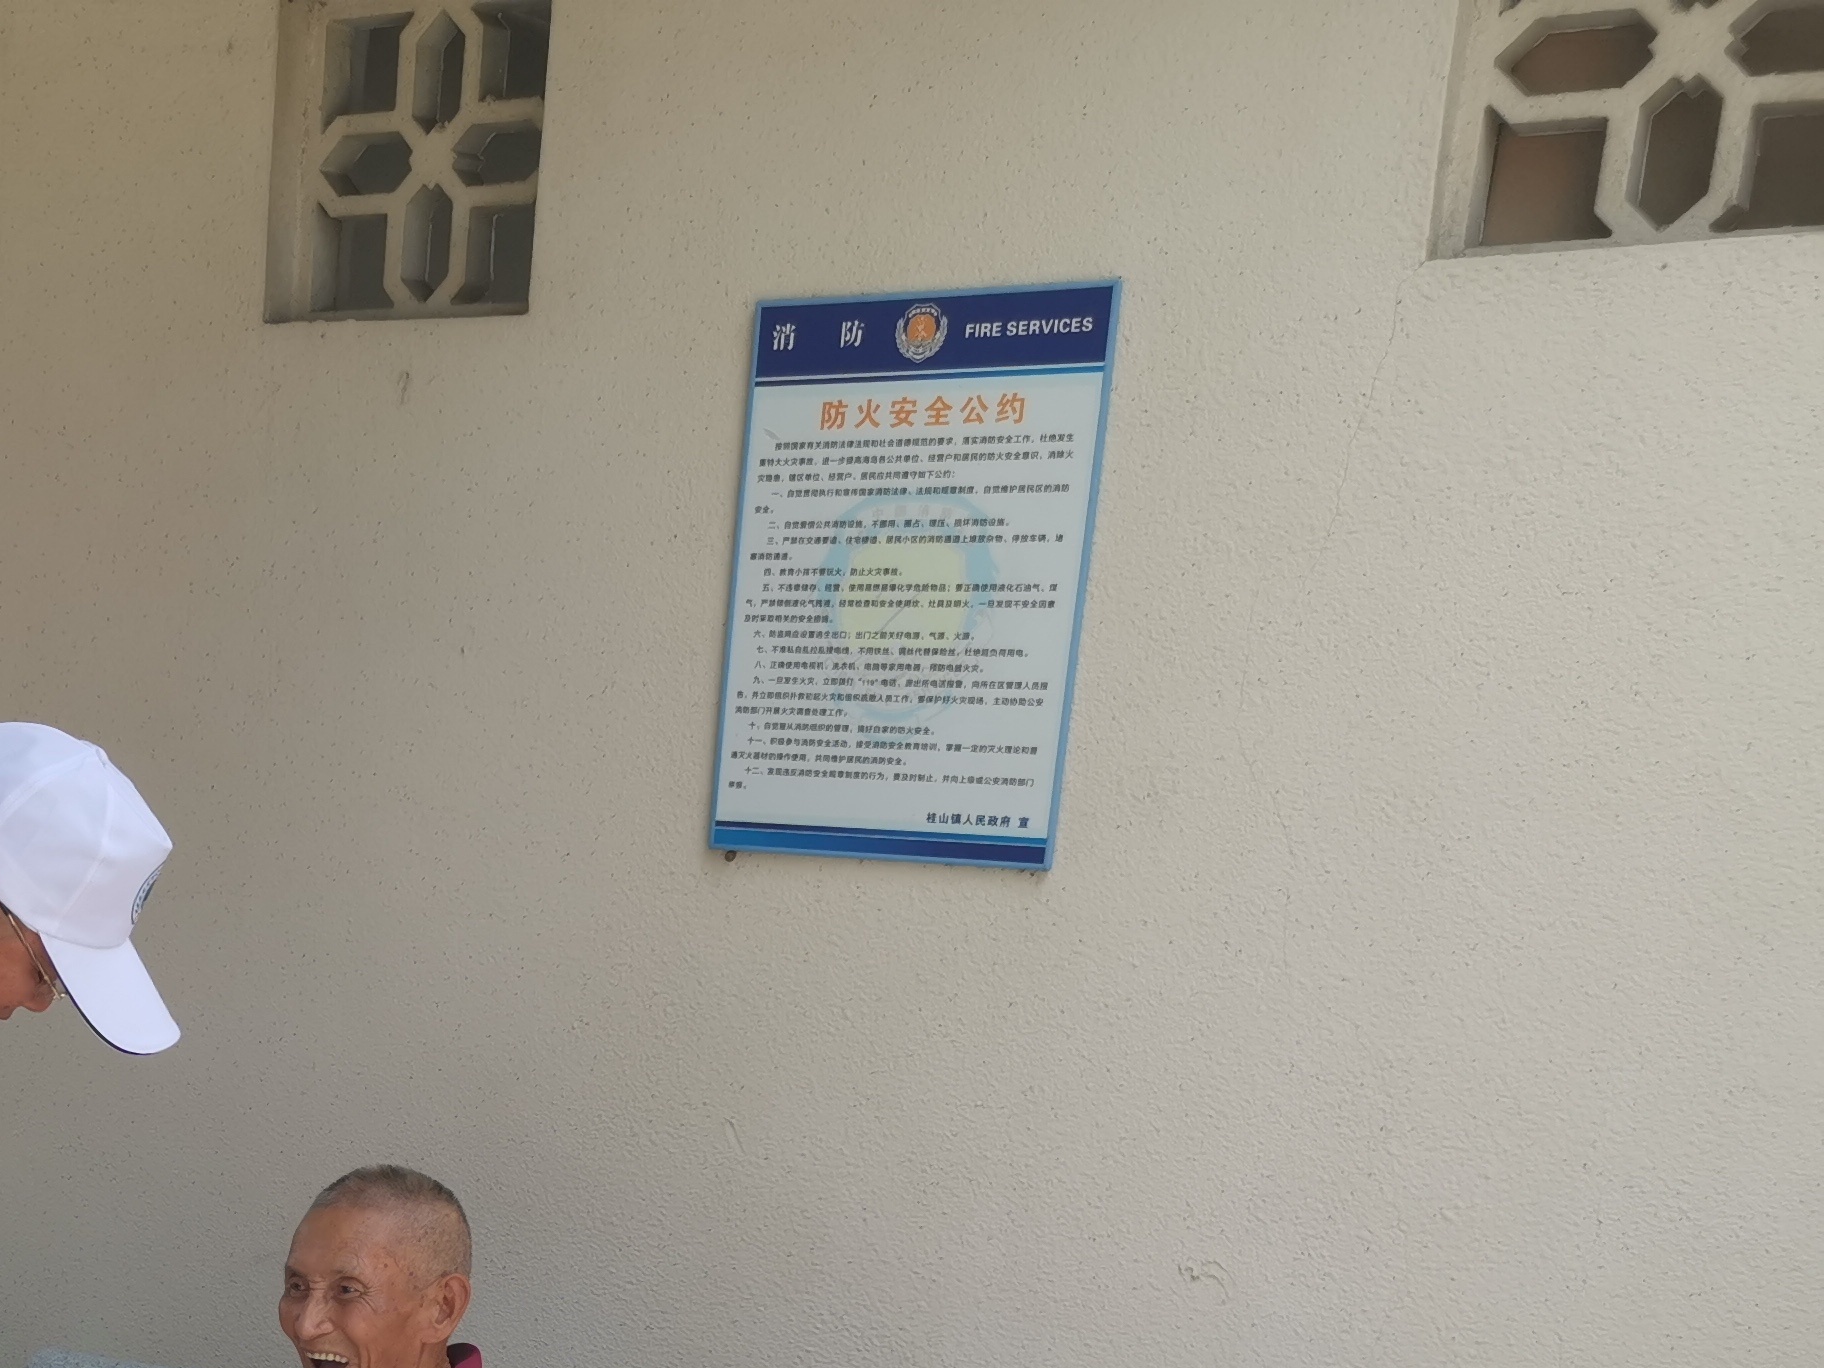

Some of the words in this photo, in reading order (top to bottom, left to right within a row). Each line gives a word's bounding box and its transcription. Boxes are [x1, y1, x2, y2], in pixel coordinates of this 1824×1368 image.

[965, 322, 1002, 339] FIRE
[1006, 317, 1093, 337] SERVICES
[819, 391, 1027, 431] 防火安全公约
[754, 505, 774, 514] 安全。
[926, 812, 1012, 828] 桂山镇人民政府
[1017, 816, 1030, 829] 宣
